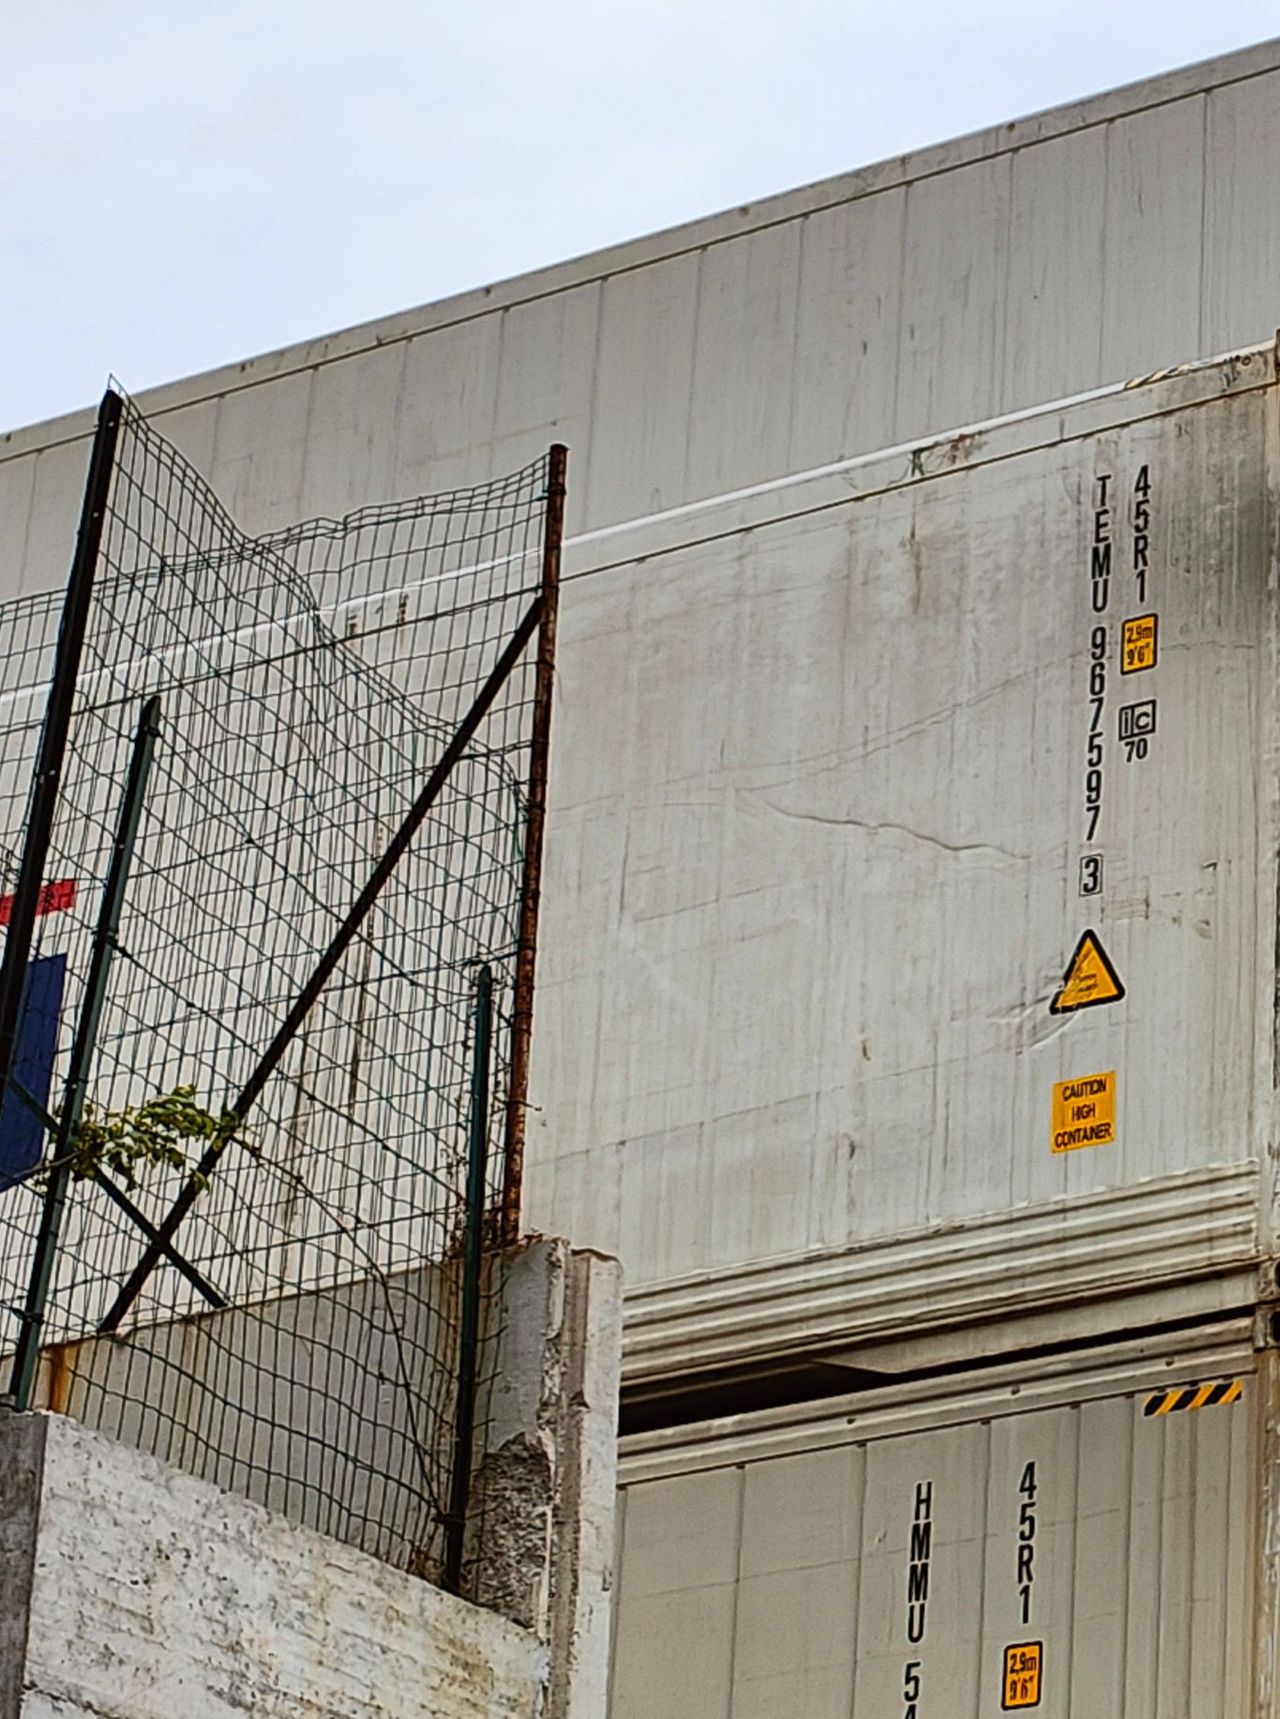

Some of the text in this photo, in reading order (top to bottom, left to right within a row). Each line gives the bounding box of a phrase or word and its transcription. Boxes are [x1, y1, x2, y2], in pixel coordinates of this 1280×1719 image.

[1133, 464, 1152, 604] 45R1
[1083, 474, 1112, 893] TEMU 967597 3
[1124, 738, 1148, 763] 70
[1062, 1078, 1107, 1101] CAUTION
[1071, 1102, 1096, 1122] HIGH
[1054, 1122, 1112, 1149] CONTAINER
[908, 1481, 933, 1644] HMMU
[1017, 1461, 1037, 1625] 45R1
